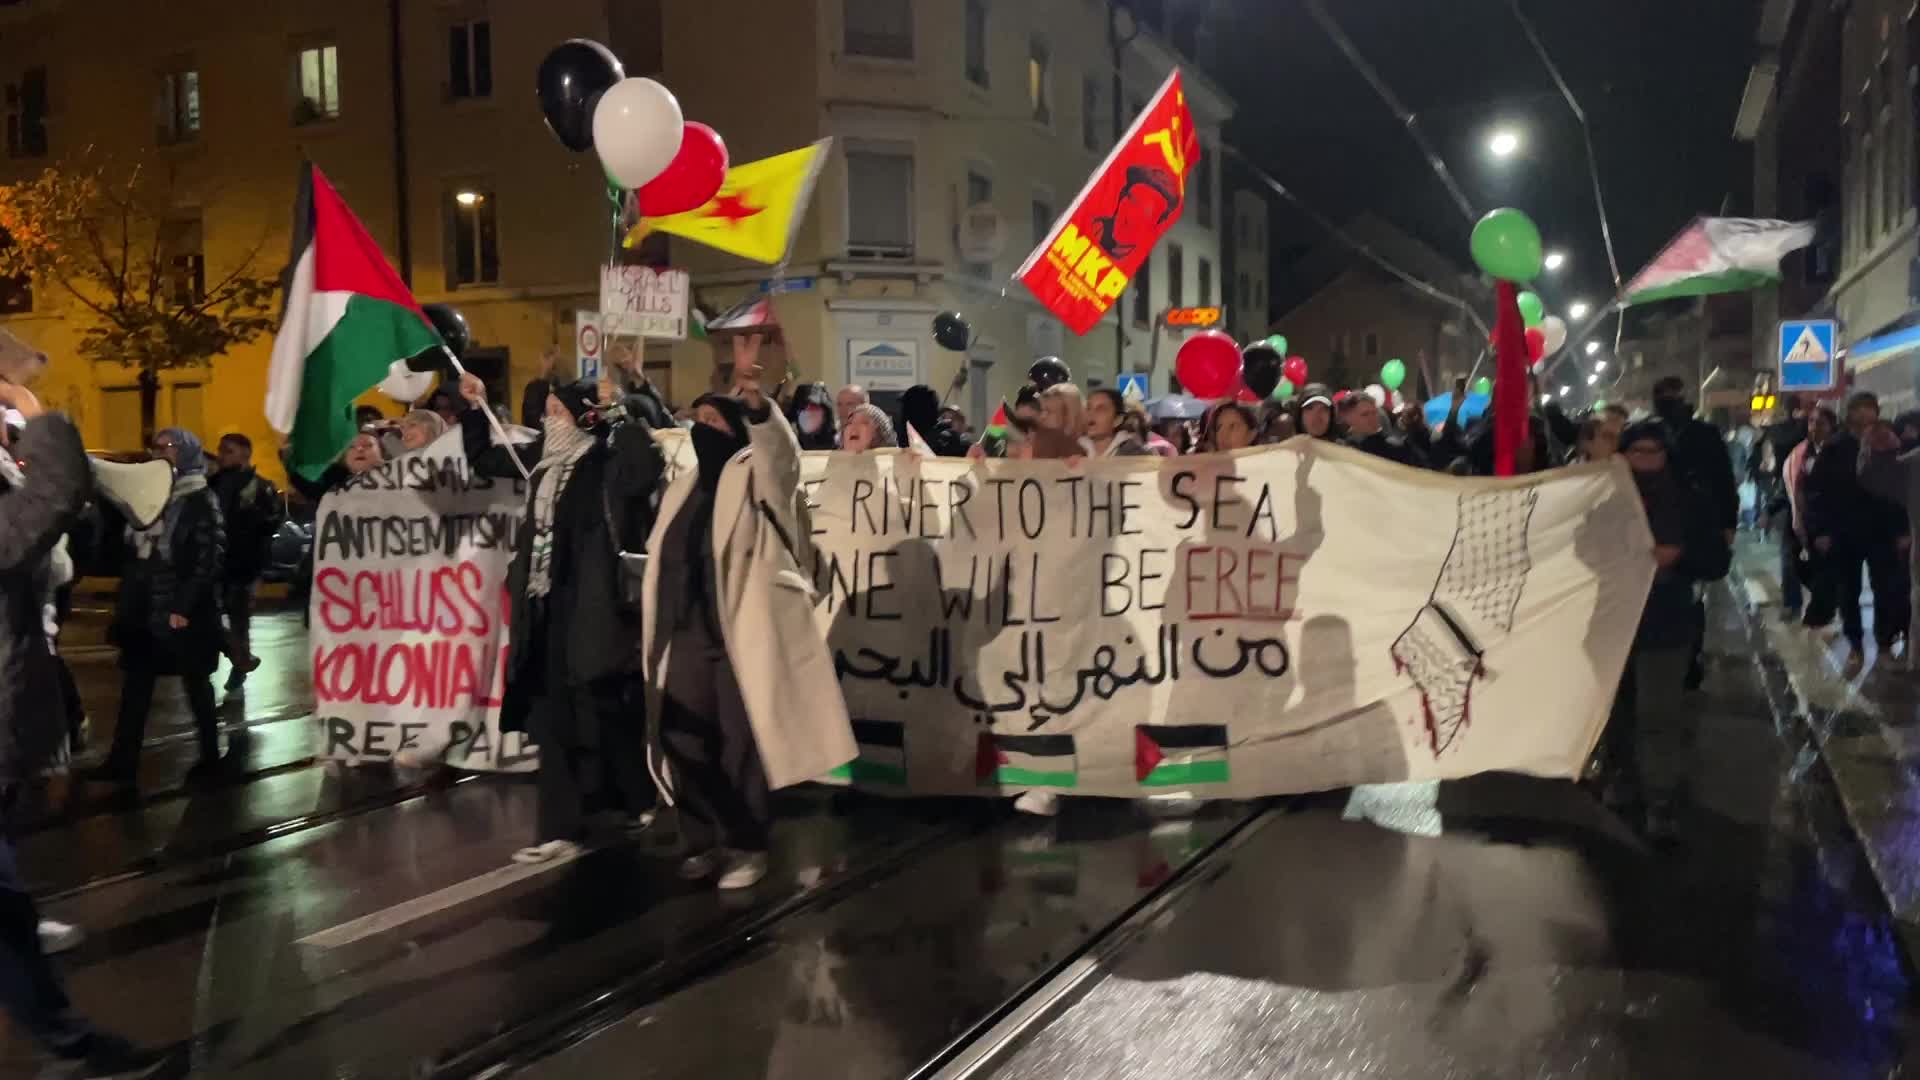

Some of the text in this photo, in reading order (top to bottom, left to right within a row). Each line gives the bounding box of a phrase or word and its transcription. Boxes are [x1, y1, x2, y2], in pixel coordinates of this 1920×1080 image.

[1051, 223, 1129, 300] MKP
[624, 295, 673, 315] KILLS
[852, 476, 977, 541] RIVER
[985, 478, 1045, 541] TO
[1056, 476, 1143, 539] THE
[1171, 470, 1277, 543] SEA
[316, 560, 489, 637] SCHLUSS
[932, 550, 1061, 628] WILL
[1102, 549, 1168, 617] BE
[1184, 546, 1306, 618] FREE
[1192, 627, 1289, 677] من
[319, 717, 429, 757] REE
